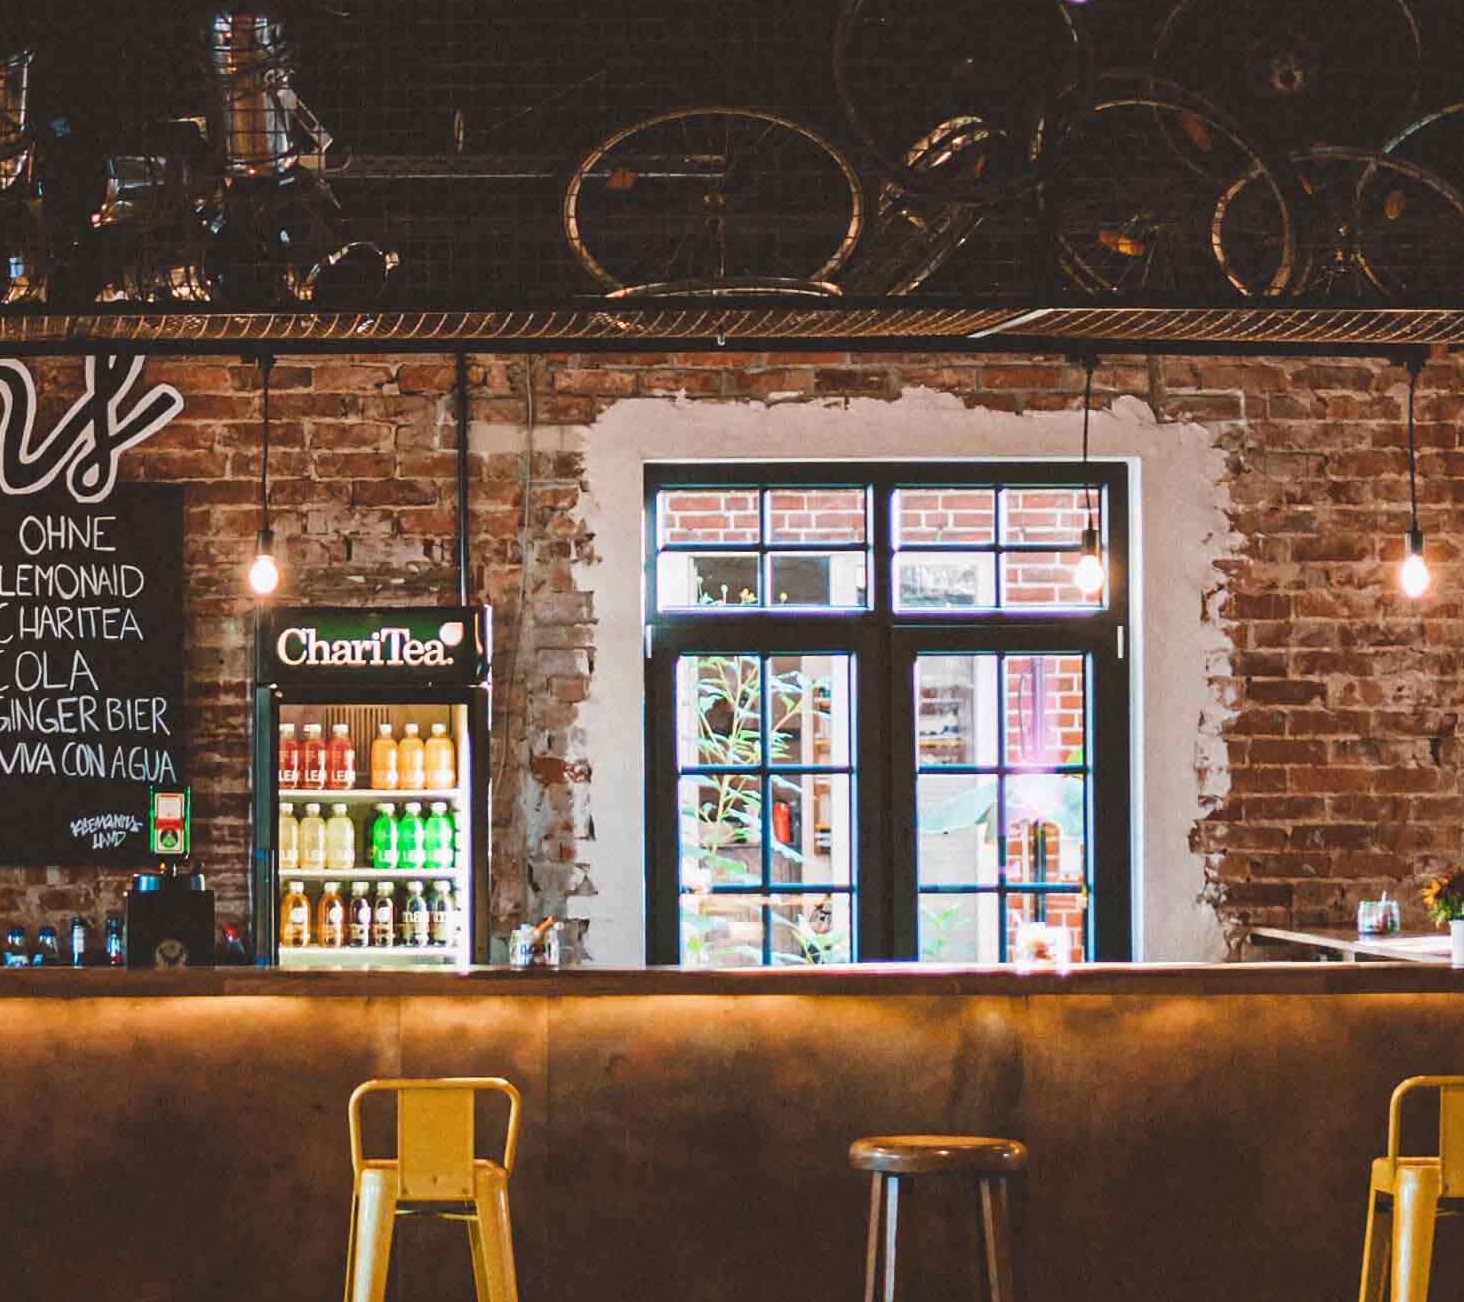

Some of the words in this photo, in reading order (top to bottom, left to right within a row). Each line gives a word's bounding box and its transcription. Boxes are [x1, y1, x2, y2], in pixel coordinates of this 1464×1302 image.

[19, 515, 117, 555] OHNE
[106, 697, 170, 736] BIER
[62, 742, 106, 778] CON
[111, 746, 177, 784] AGUA
